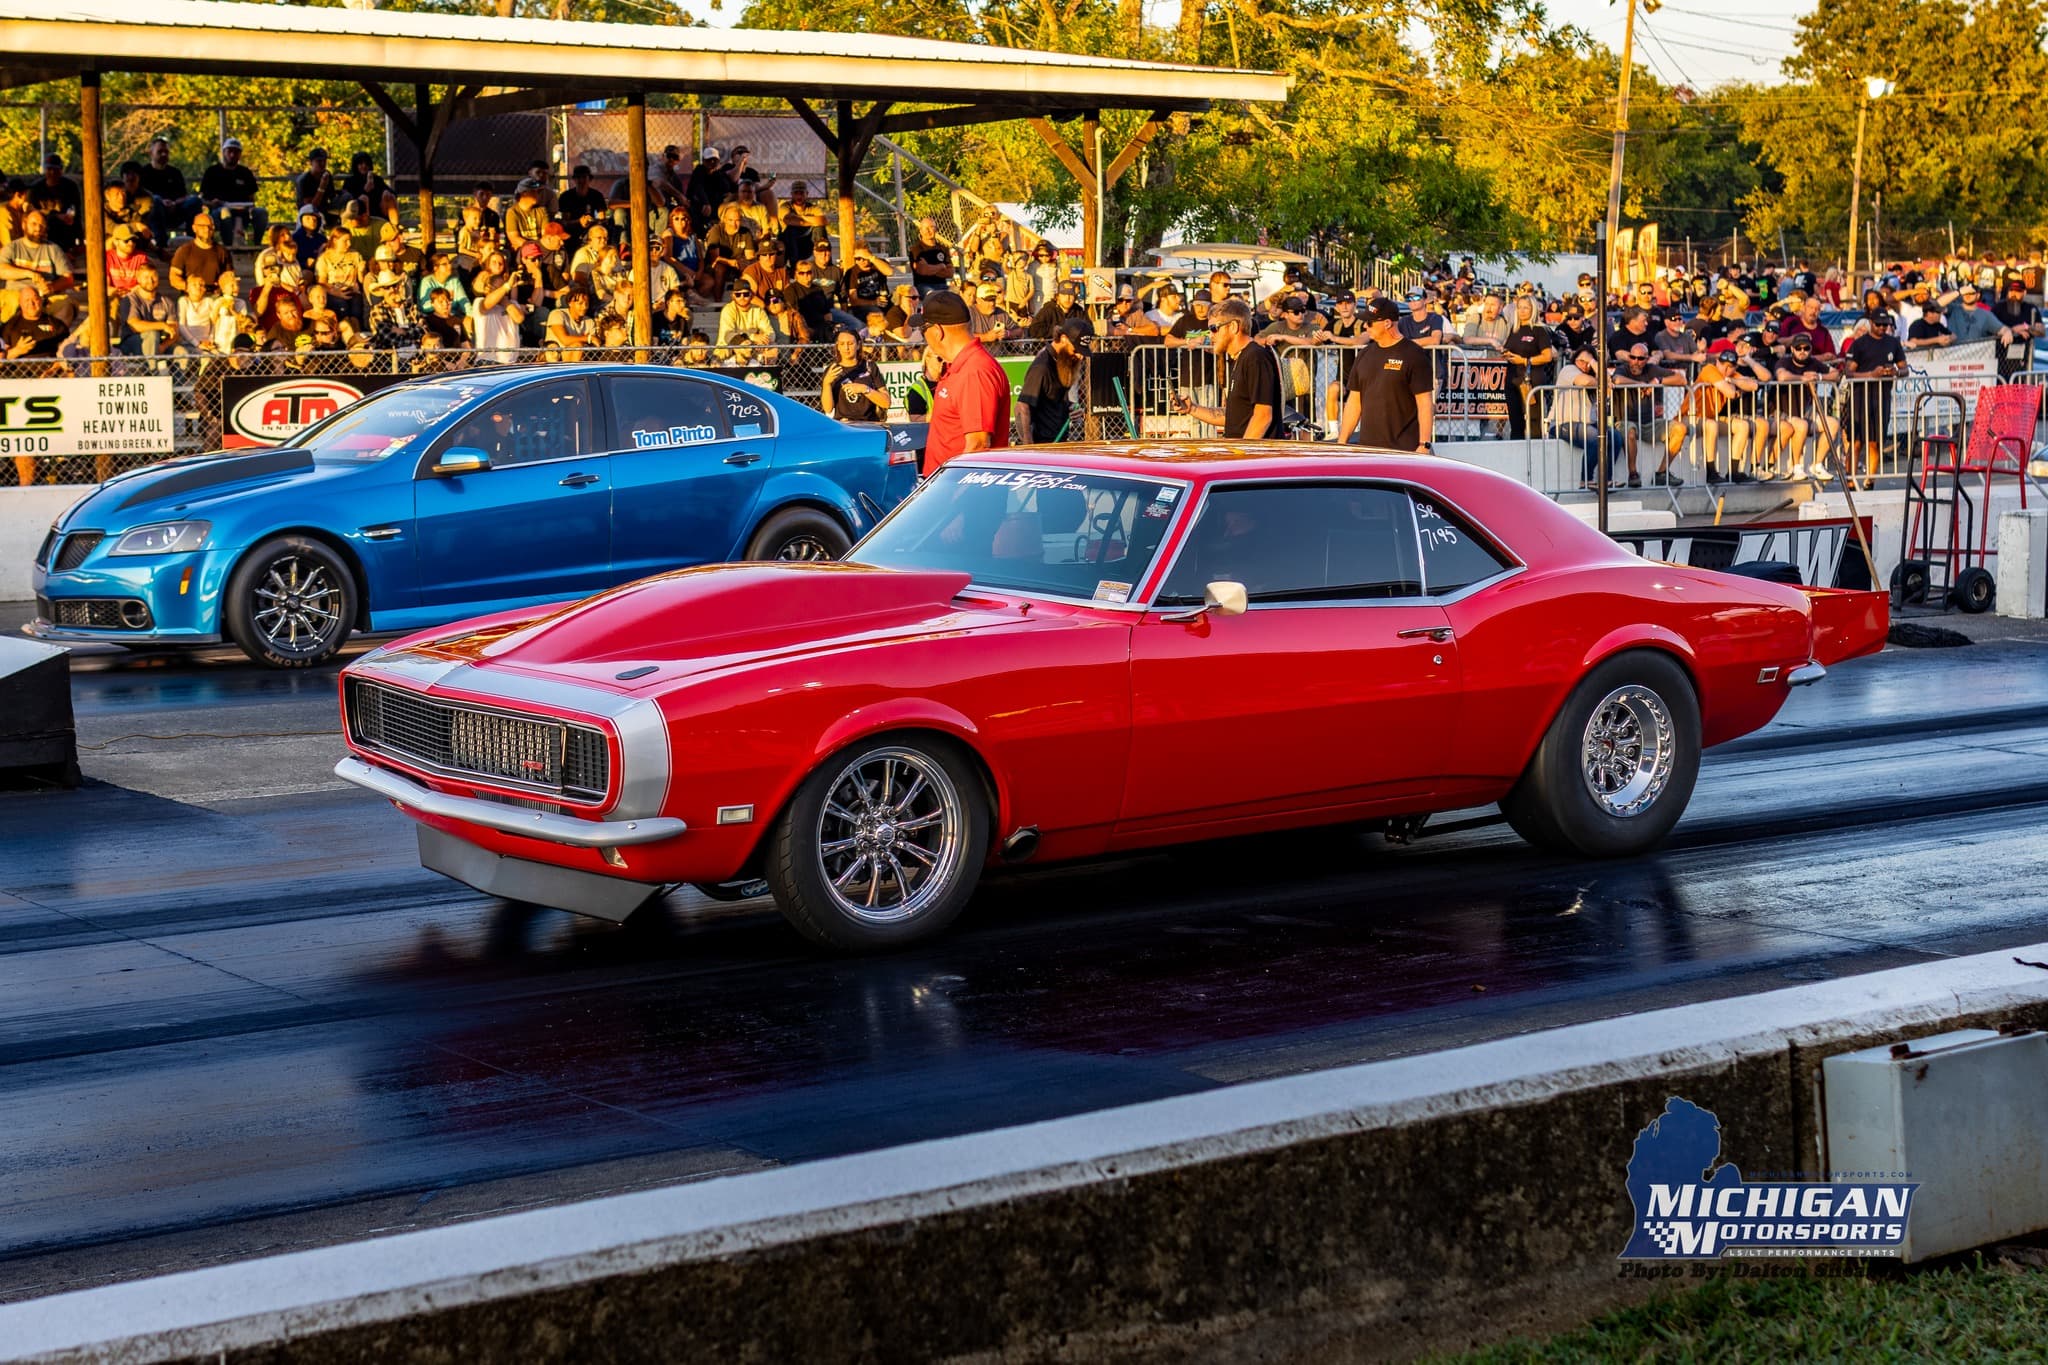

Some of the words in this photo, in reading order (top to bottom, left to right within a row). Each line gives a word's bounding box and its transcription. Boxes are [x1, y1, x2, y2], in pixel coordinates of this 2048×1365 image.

[98, 383, 145, 397] REPAIR
[97, 400, 149, 415] TOWING
[262, 392, 339, 425] ATM
[83, 419, 126, 434] HEAVY
[129, 418, 163, 433] HAUL
[77, 439, 120, 450] BOWLING
[157, 437, 169, 449] KY
[633, 431, 669, 448] Tom
[669, 425, 716, 445] Pinto
[1420, 525, 1458, 551] 7195
